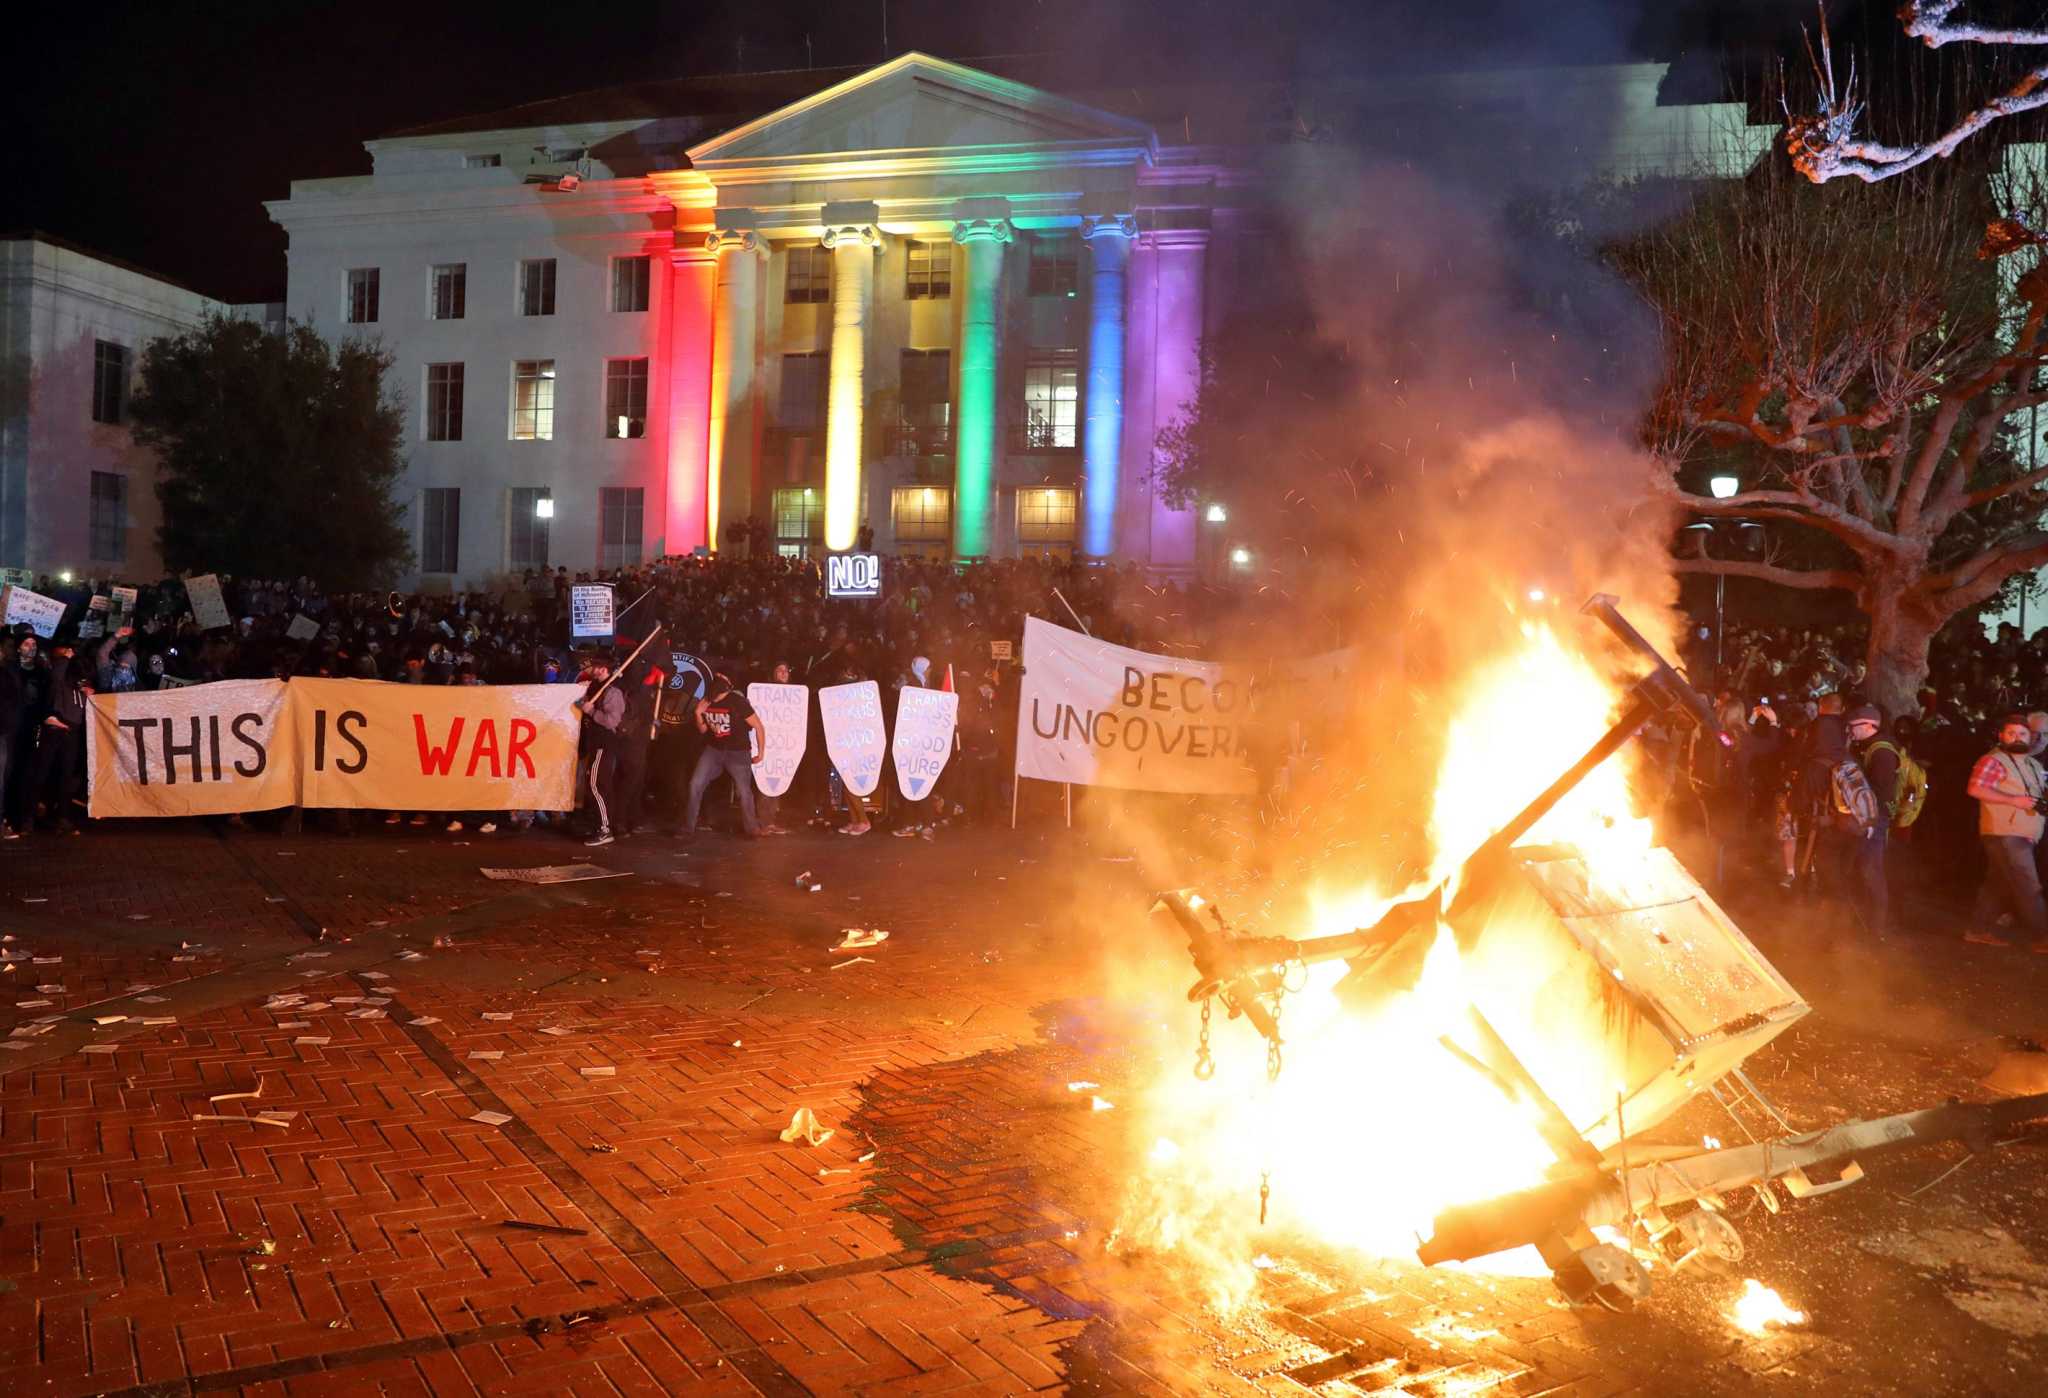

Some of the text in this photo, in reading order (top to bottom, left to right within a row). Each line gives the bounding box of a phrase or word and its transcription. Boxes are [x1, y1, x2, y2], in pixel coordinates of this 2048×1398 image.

[829, 555, 879, 588] NO!
[752, 686, 803, 705] TRANS
[119, 710, 537, 785] THIS IS WAR
